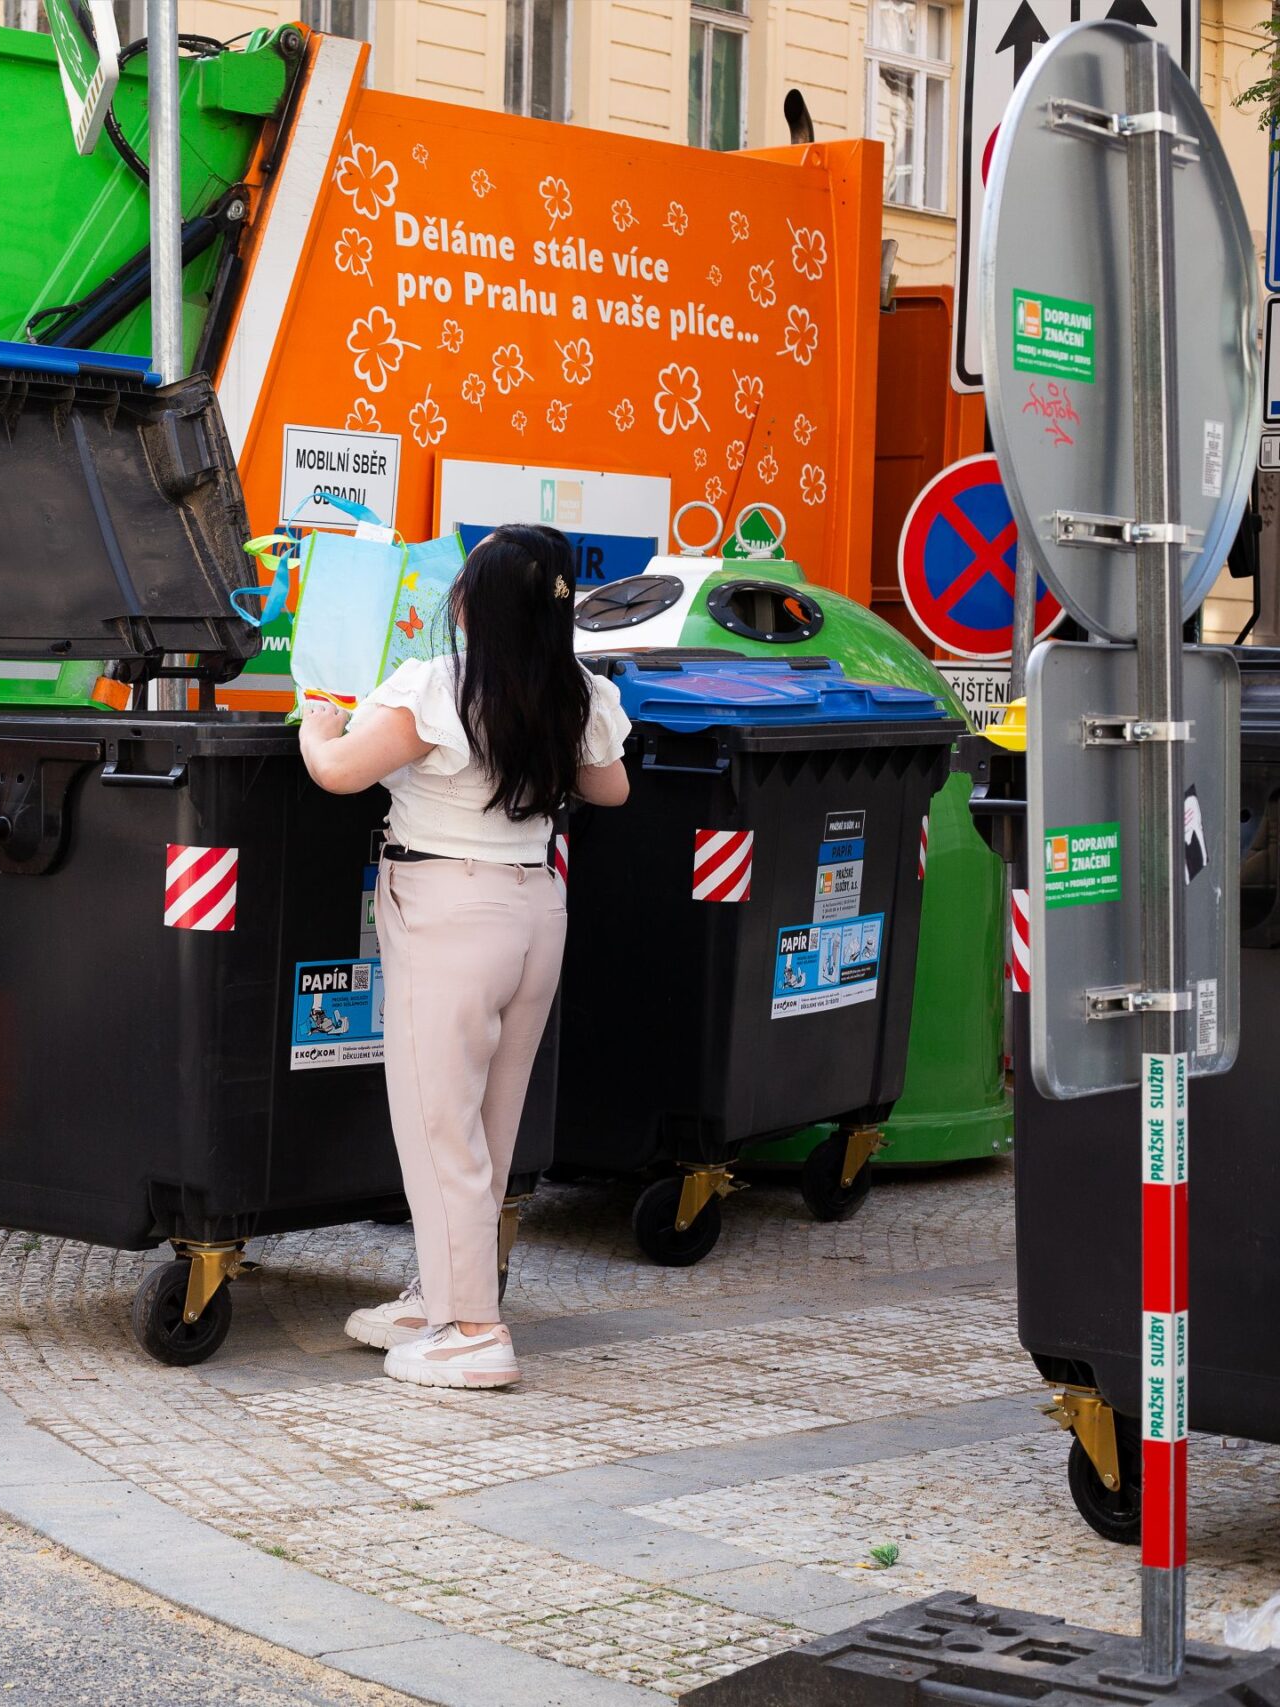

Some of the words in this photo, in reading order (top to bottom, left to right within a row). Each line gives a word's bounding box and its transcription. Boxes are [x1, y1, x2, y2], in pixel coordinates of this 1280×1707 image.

[395, 211, 515, 262] Děláme
[533, 236, 604, 273] stále
[612, 246, 669, 283] více
[397, 271, 452, 307] pro
[464, 271, 557, 317] Prahu
[572, 294, 588, 320] a
[597, 294, 660, 330] vaše
[670, 301, 759, 344] plíce...
[1044, 307, 1092, 331] DOPRAVNÍ
[1045, 326, 1085, 348] ZNAČENÍ
[296, 448, 350, 473] MOBILNÍ
[352, 450, 387, 475] SBĚR
[1071, 832, 1118, 853] DOPRAVNÍ
[1071, 851, 1111, 872] ZNAČENÍ
[781, 931, 807, 953] PAPÍR
[302, 967, 348, 992] PAPÍR
[1148, 1057, 1164, 1108] SLUŽBY
[1176, 1057, 1184, 1108] SLUŽBY
[1148, 1119, 1164, 1181] PRAŽSKÉ
[1148, 1316, 1164, 1367] SLUŽBY
[1176, 1316, 1184, 1367] SLUŽBY
[1148, 1376, 1164, 1438] PRAŽSKÉ
